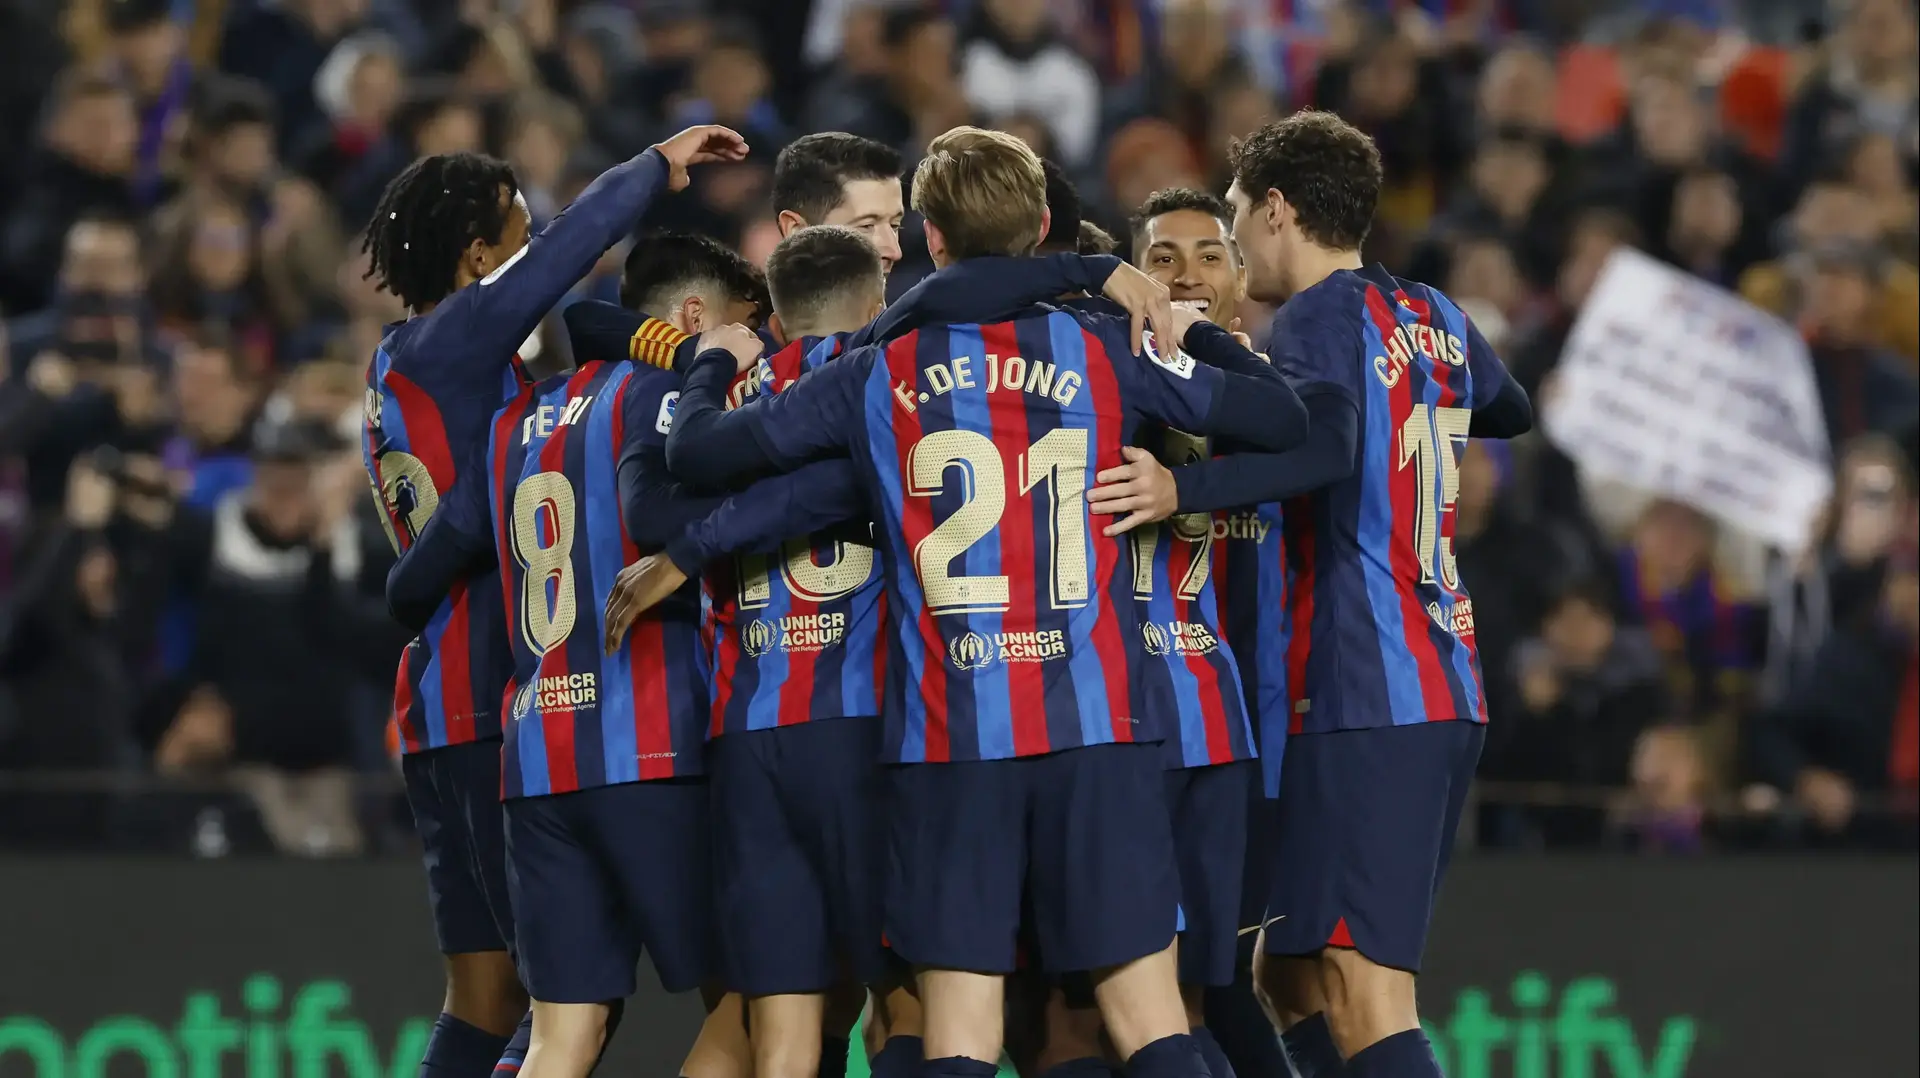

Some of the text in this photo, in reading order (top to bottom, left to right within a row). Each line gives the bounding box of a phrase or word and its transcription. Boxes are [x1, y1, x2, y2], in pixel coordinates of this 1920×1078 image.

[985, 353, 1082, 407] JONG
[907, 428, 1091, 616] 21
[510, 470, 576, 658] 8
[779, 612, 845, 632] UNHCR
[780, 627, 844, 646] ACNUR
[994, 629, 1063, 647] UNHCR
[998, 641, 1066, 660] ACNUR
[535, 672, 596, 693] UNHCR
[534, 687, 597, 709] ACNUR
